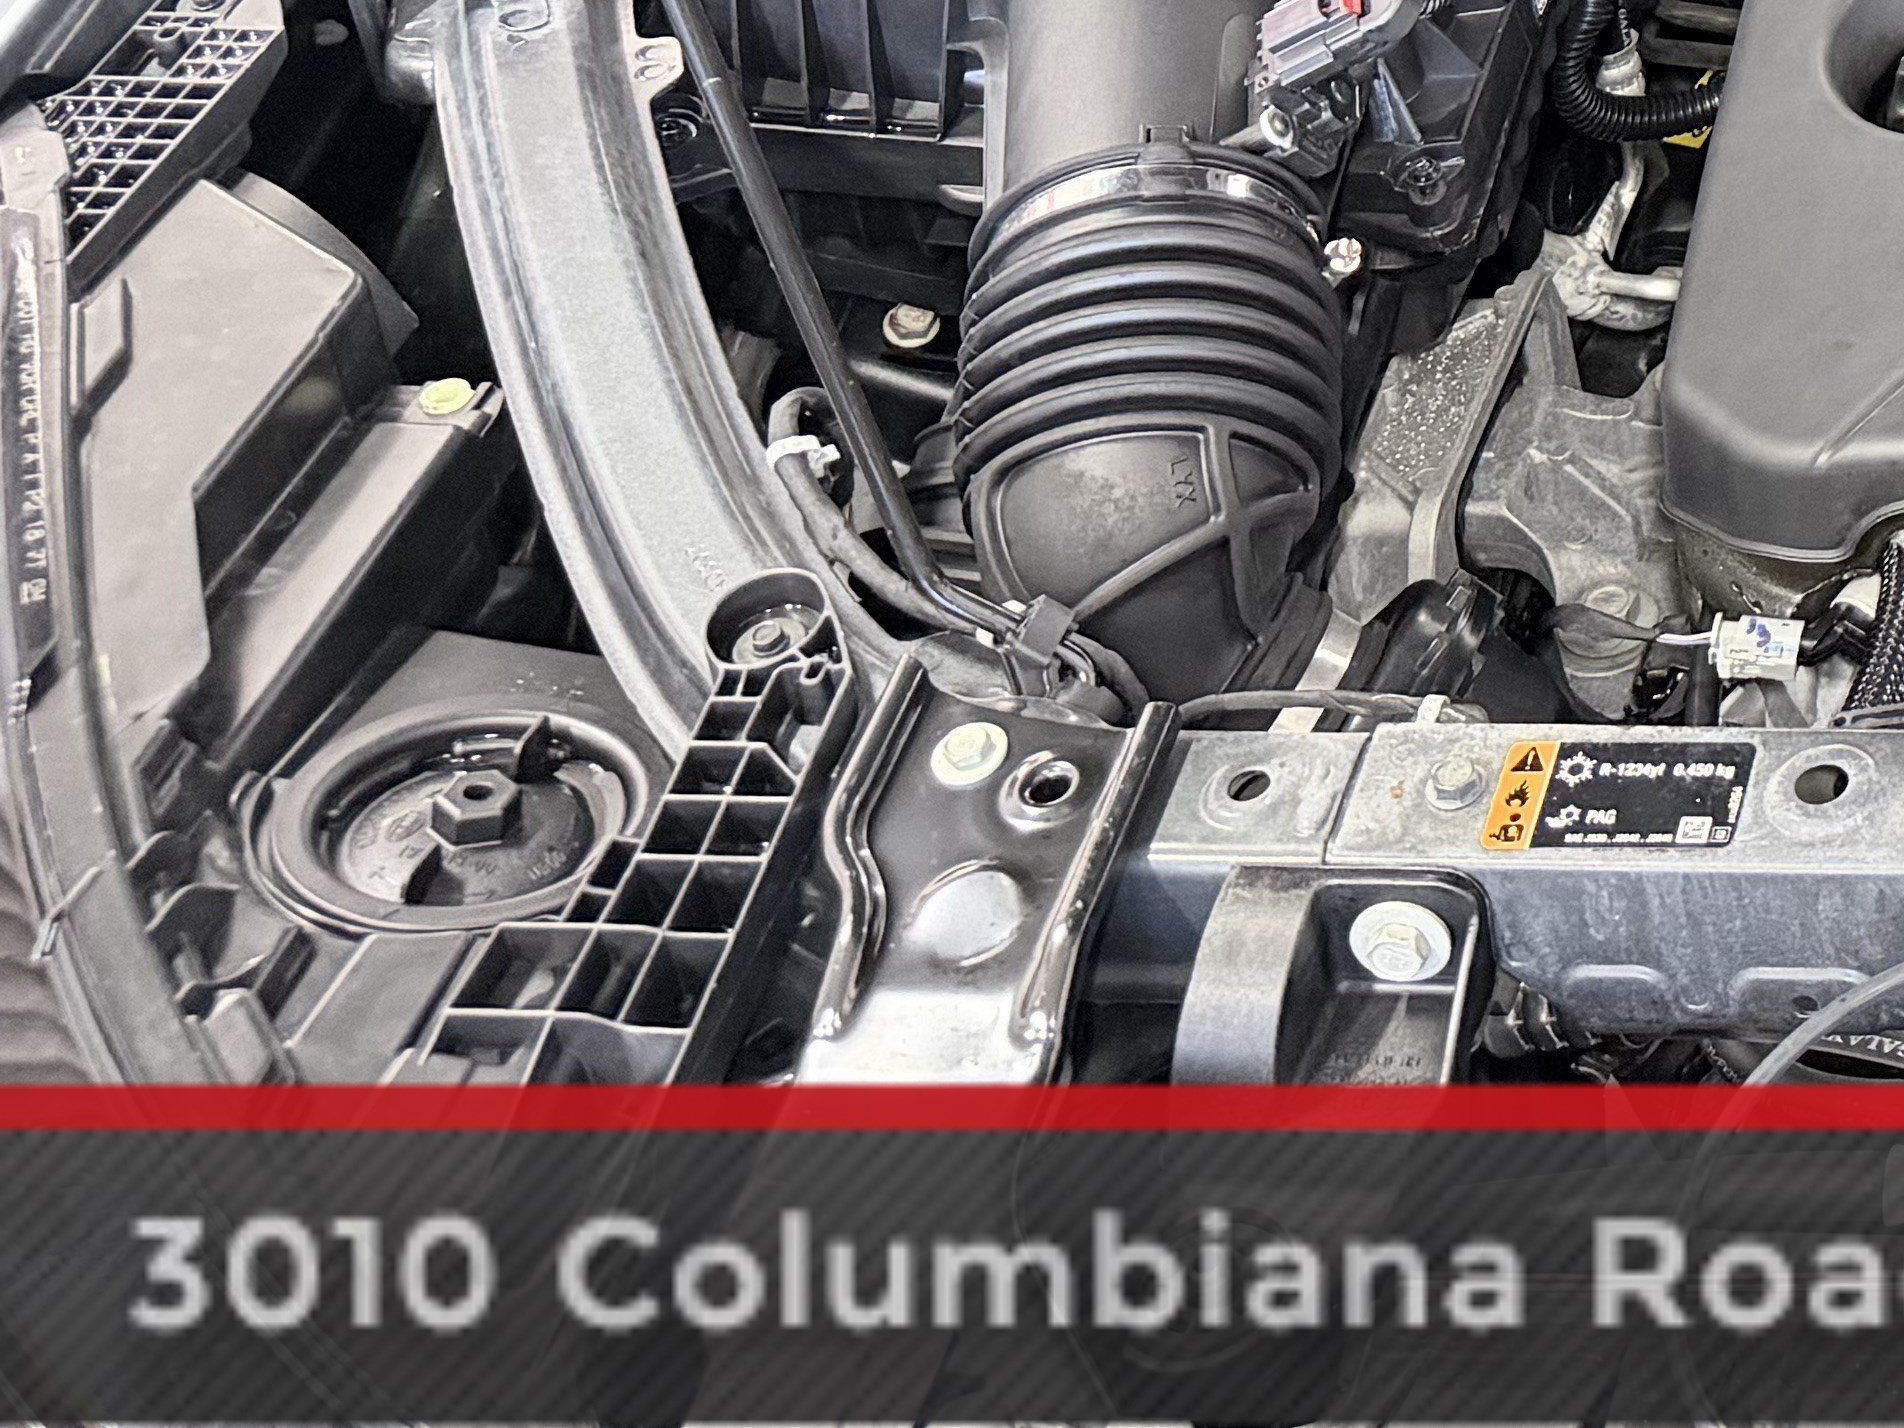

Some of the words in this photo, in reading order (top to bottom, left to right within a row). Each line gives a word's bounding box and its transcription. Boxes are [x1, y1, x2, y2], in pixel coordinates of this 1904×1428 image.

[1599, 763, 1667, 779] R-1234yf
[1673, 763, 1715, 777] 0.450
[1715, 763, 1736, 780] kg
[1585, 809, 1618, 825] PAG
